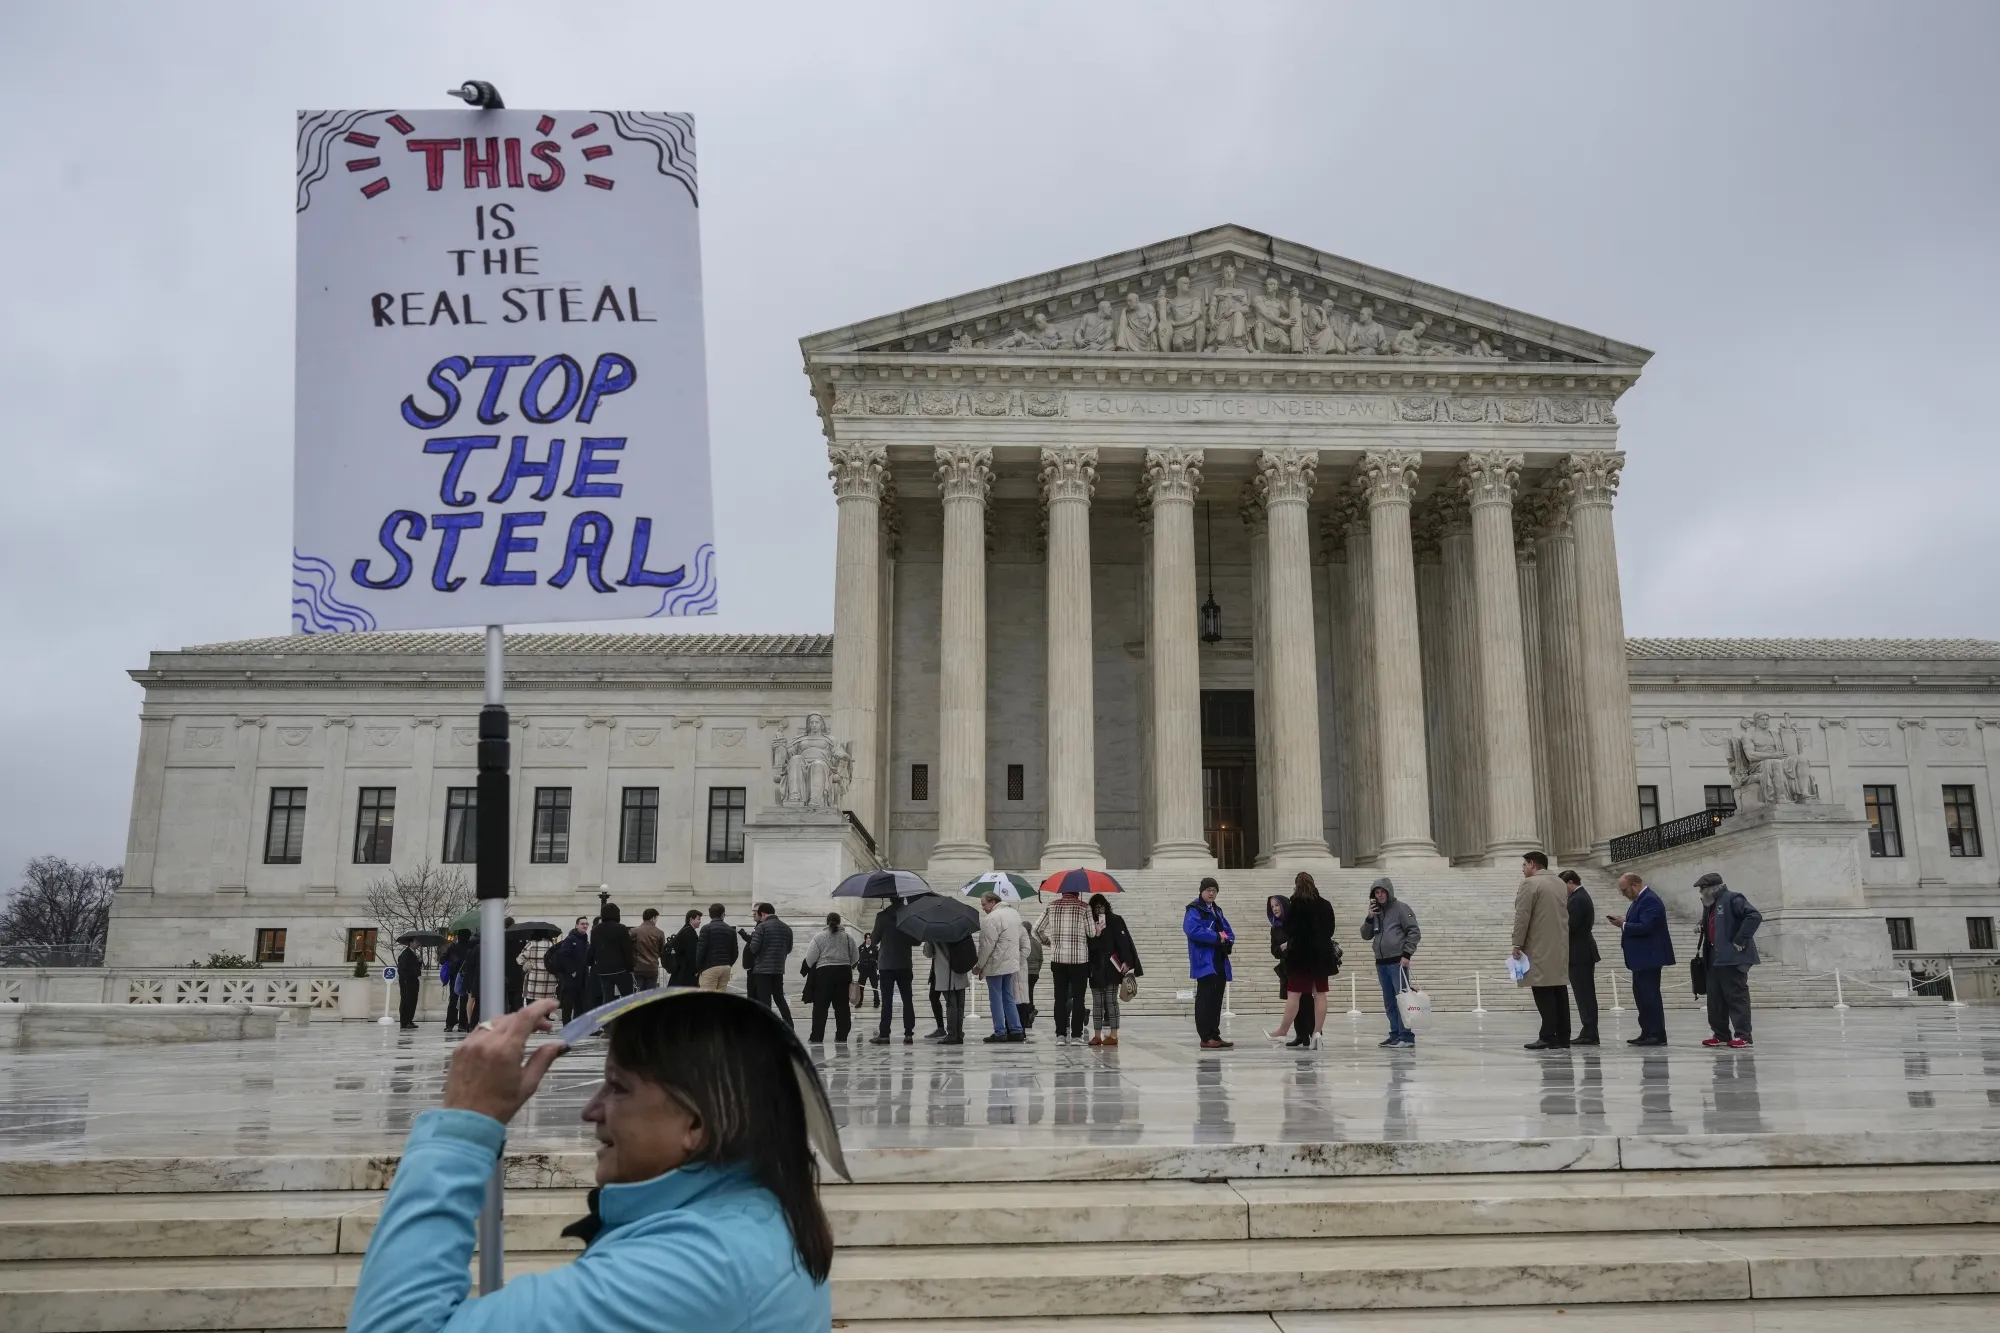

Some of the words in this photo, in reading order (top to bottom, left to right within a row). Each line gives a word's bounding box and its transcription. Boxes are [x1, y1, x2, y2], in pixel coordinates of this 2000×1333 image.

[406, 136, 566, 192] THIS
[475, 202, 515, 240] IS
[447, 246, 540, 276] THE
[371, 290, 487, 327] REAL
[502, 284, 658, 323] STEAL
[400, 352, 637, 430] STOP
[1083, 397, 1157, 414] EQUAL
[1161, 399, 1246, 415] JUSTICE
[1256, 400, 1329, 416] UNDER
[1336, 401, 1377, 416] LAW
[422, 434, 628, 507] THE
[350, 509, 686, 592] STEAL
